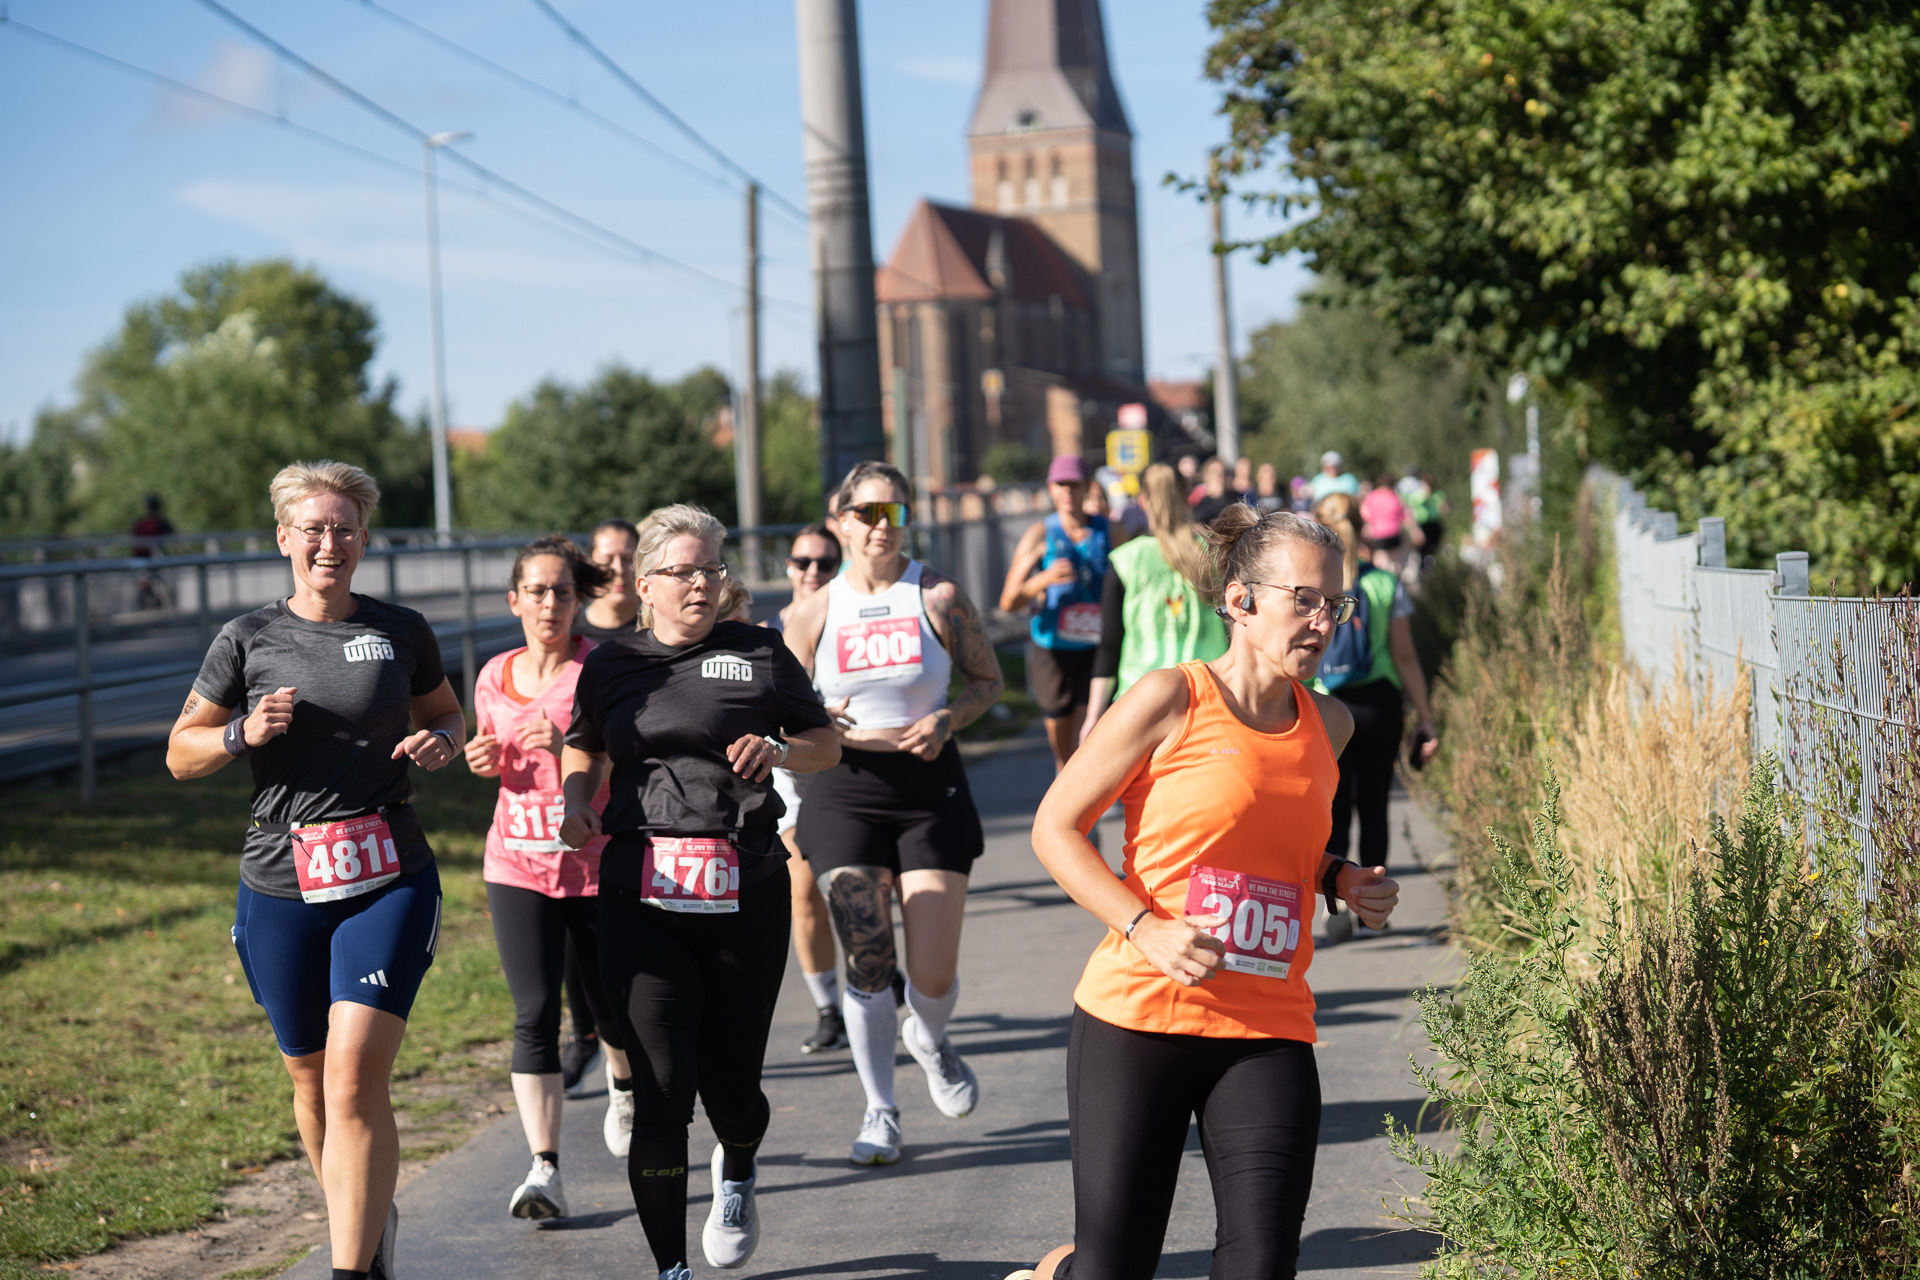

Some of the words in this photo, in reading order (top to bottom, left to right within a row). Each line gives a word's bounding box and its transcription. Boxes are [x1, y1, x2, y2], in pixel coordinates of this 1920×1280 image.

[343, 643, 394, 662] WIRO
[844, 630, 911, 670] 200
[701, 662, 752, 681] WIRO
[508, 804, 565, 838] 315
[307, 833, 382, 884] 481
[652, 856, 729, 896] 476
[1249, 883, 1256, 891] WE
[1257, 884, 1268, 893] OWN
[1269, 886, 1278, 896] THE
[1279, 888, 1297, 899] STREETS
[642, 1167, 684, 1176] cep
